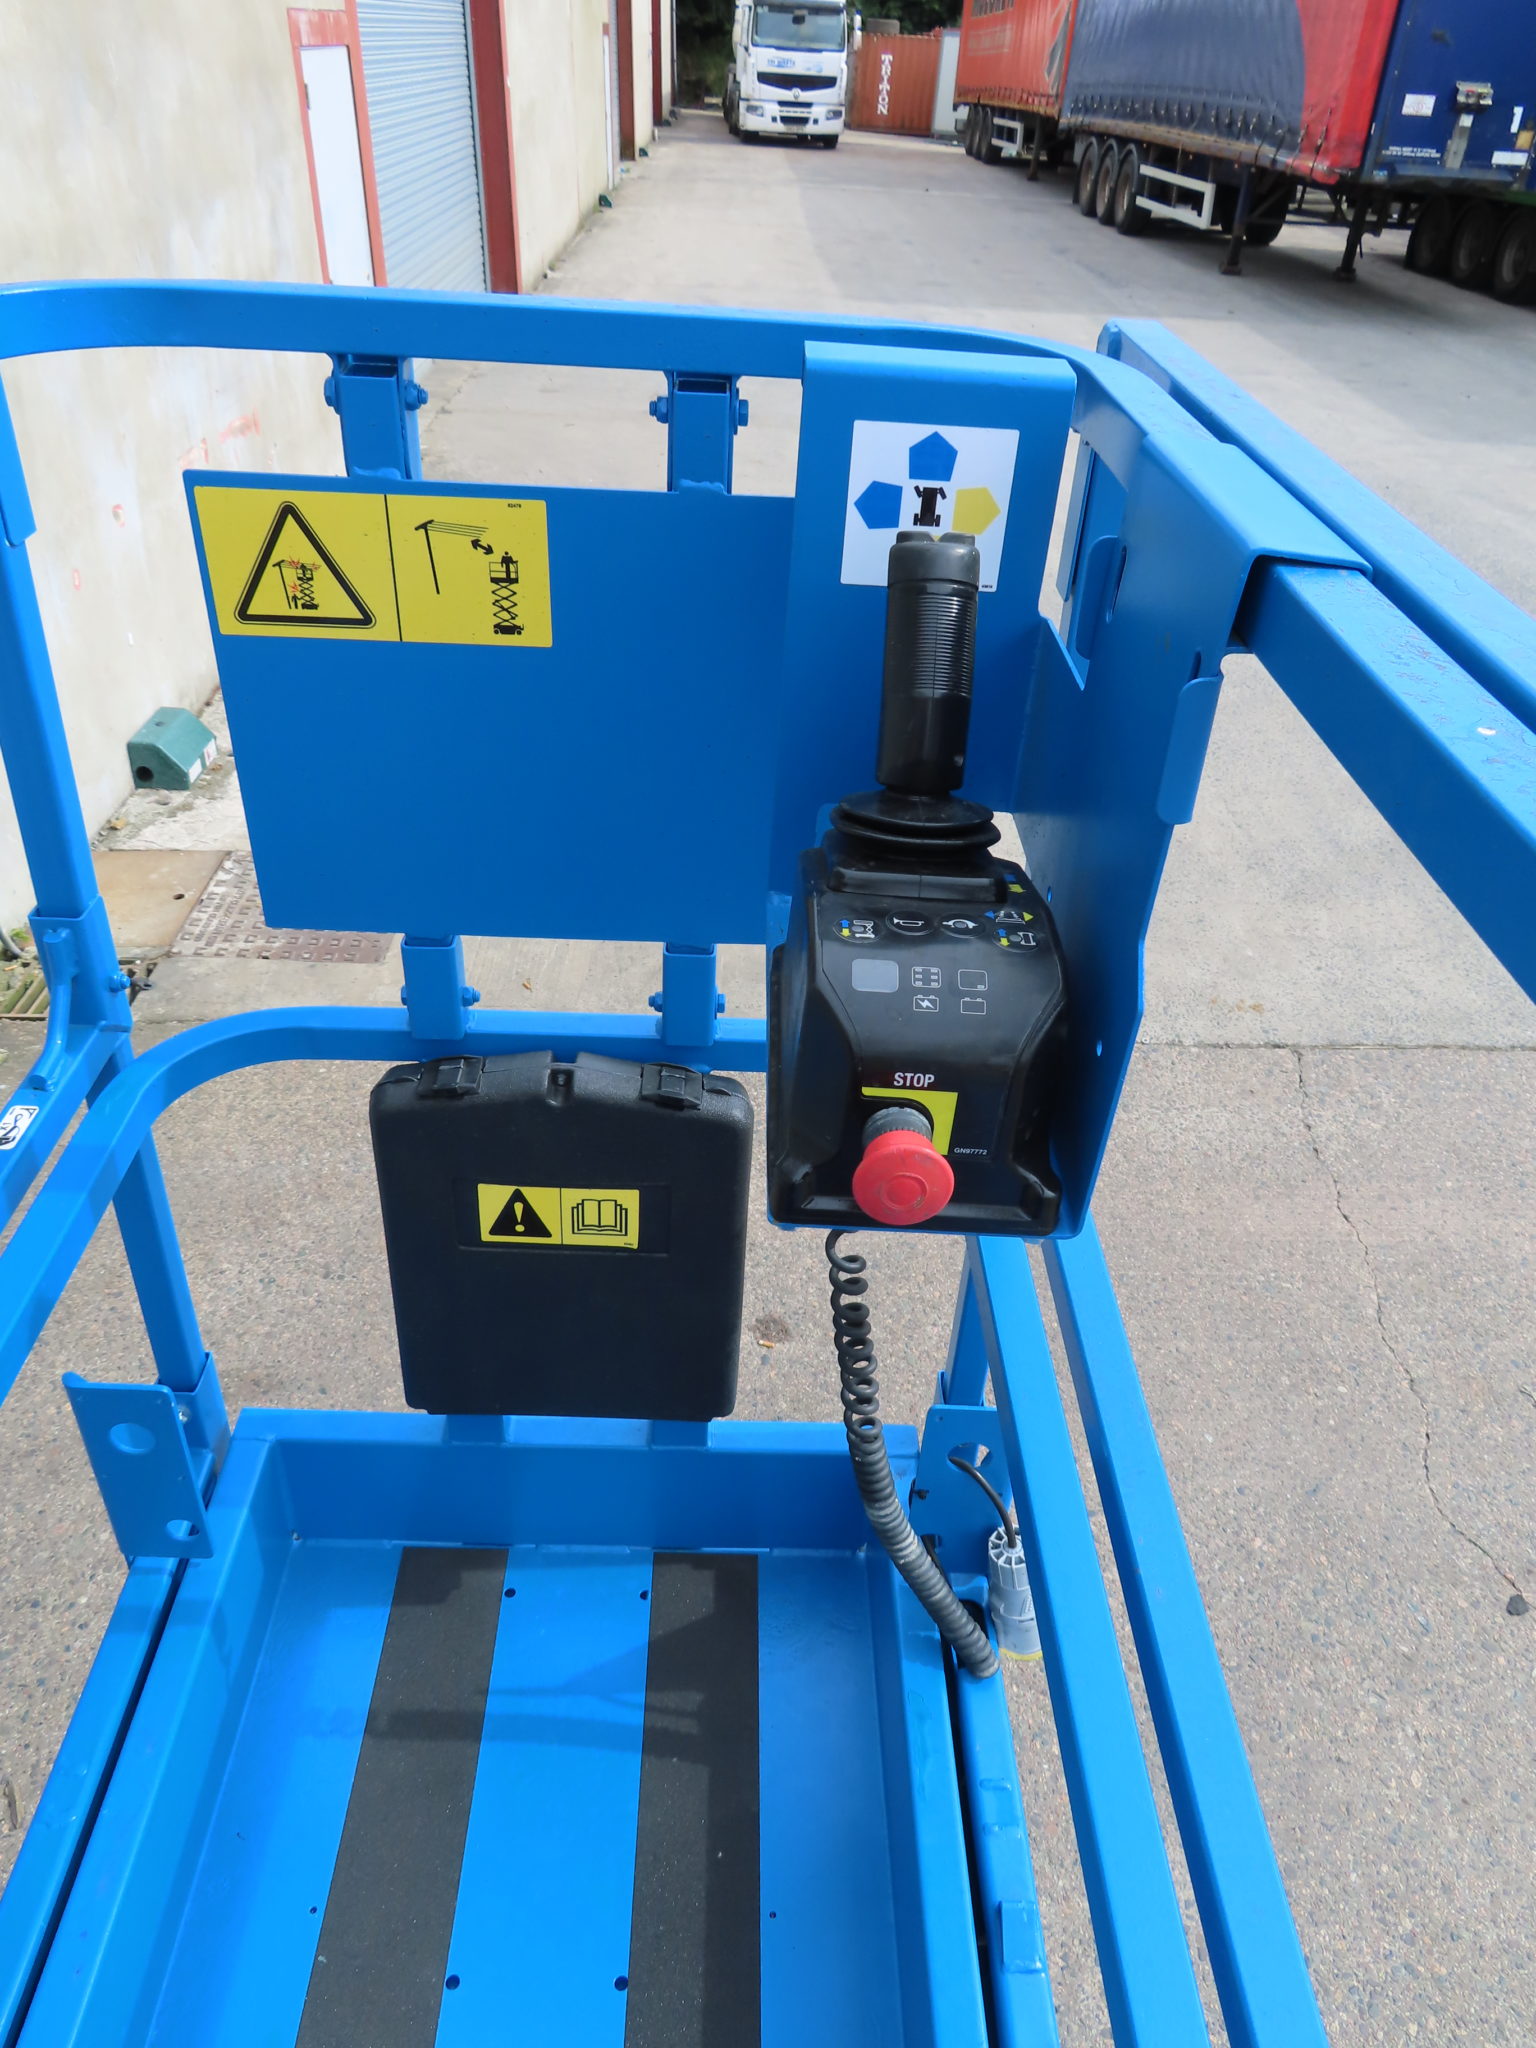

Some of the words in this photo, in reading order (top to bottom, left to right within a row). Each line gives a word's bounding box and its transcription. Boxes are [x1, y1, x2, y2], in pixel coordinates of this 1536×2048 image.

[877, 54, 893, 115] TRITON
[893, 1072, 935, 1088] STOP
[953, 1147, 988, 1156] GN97772
